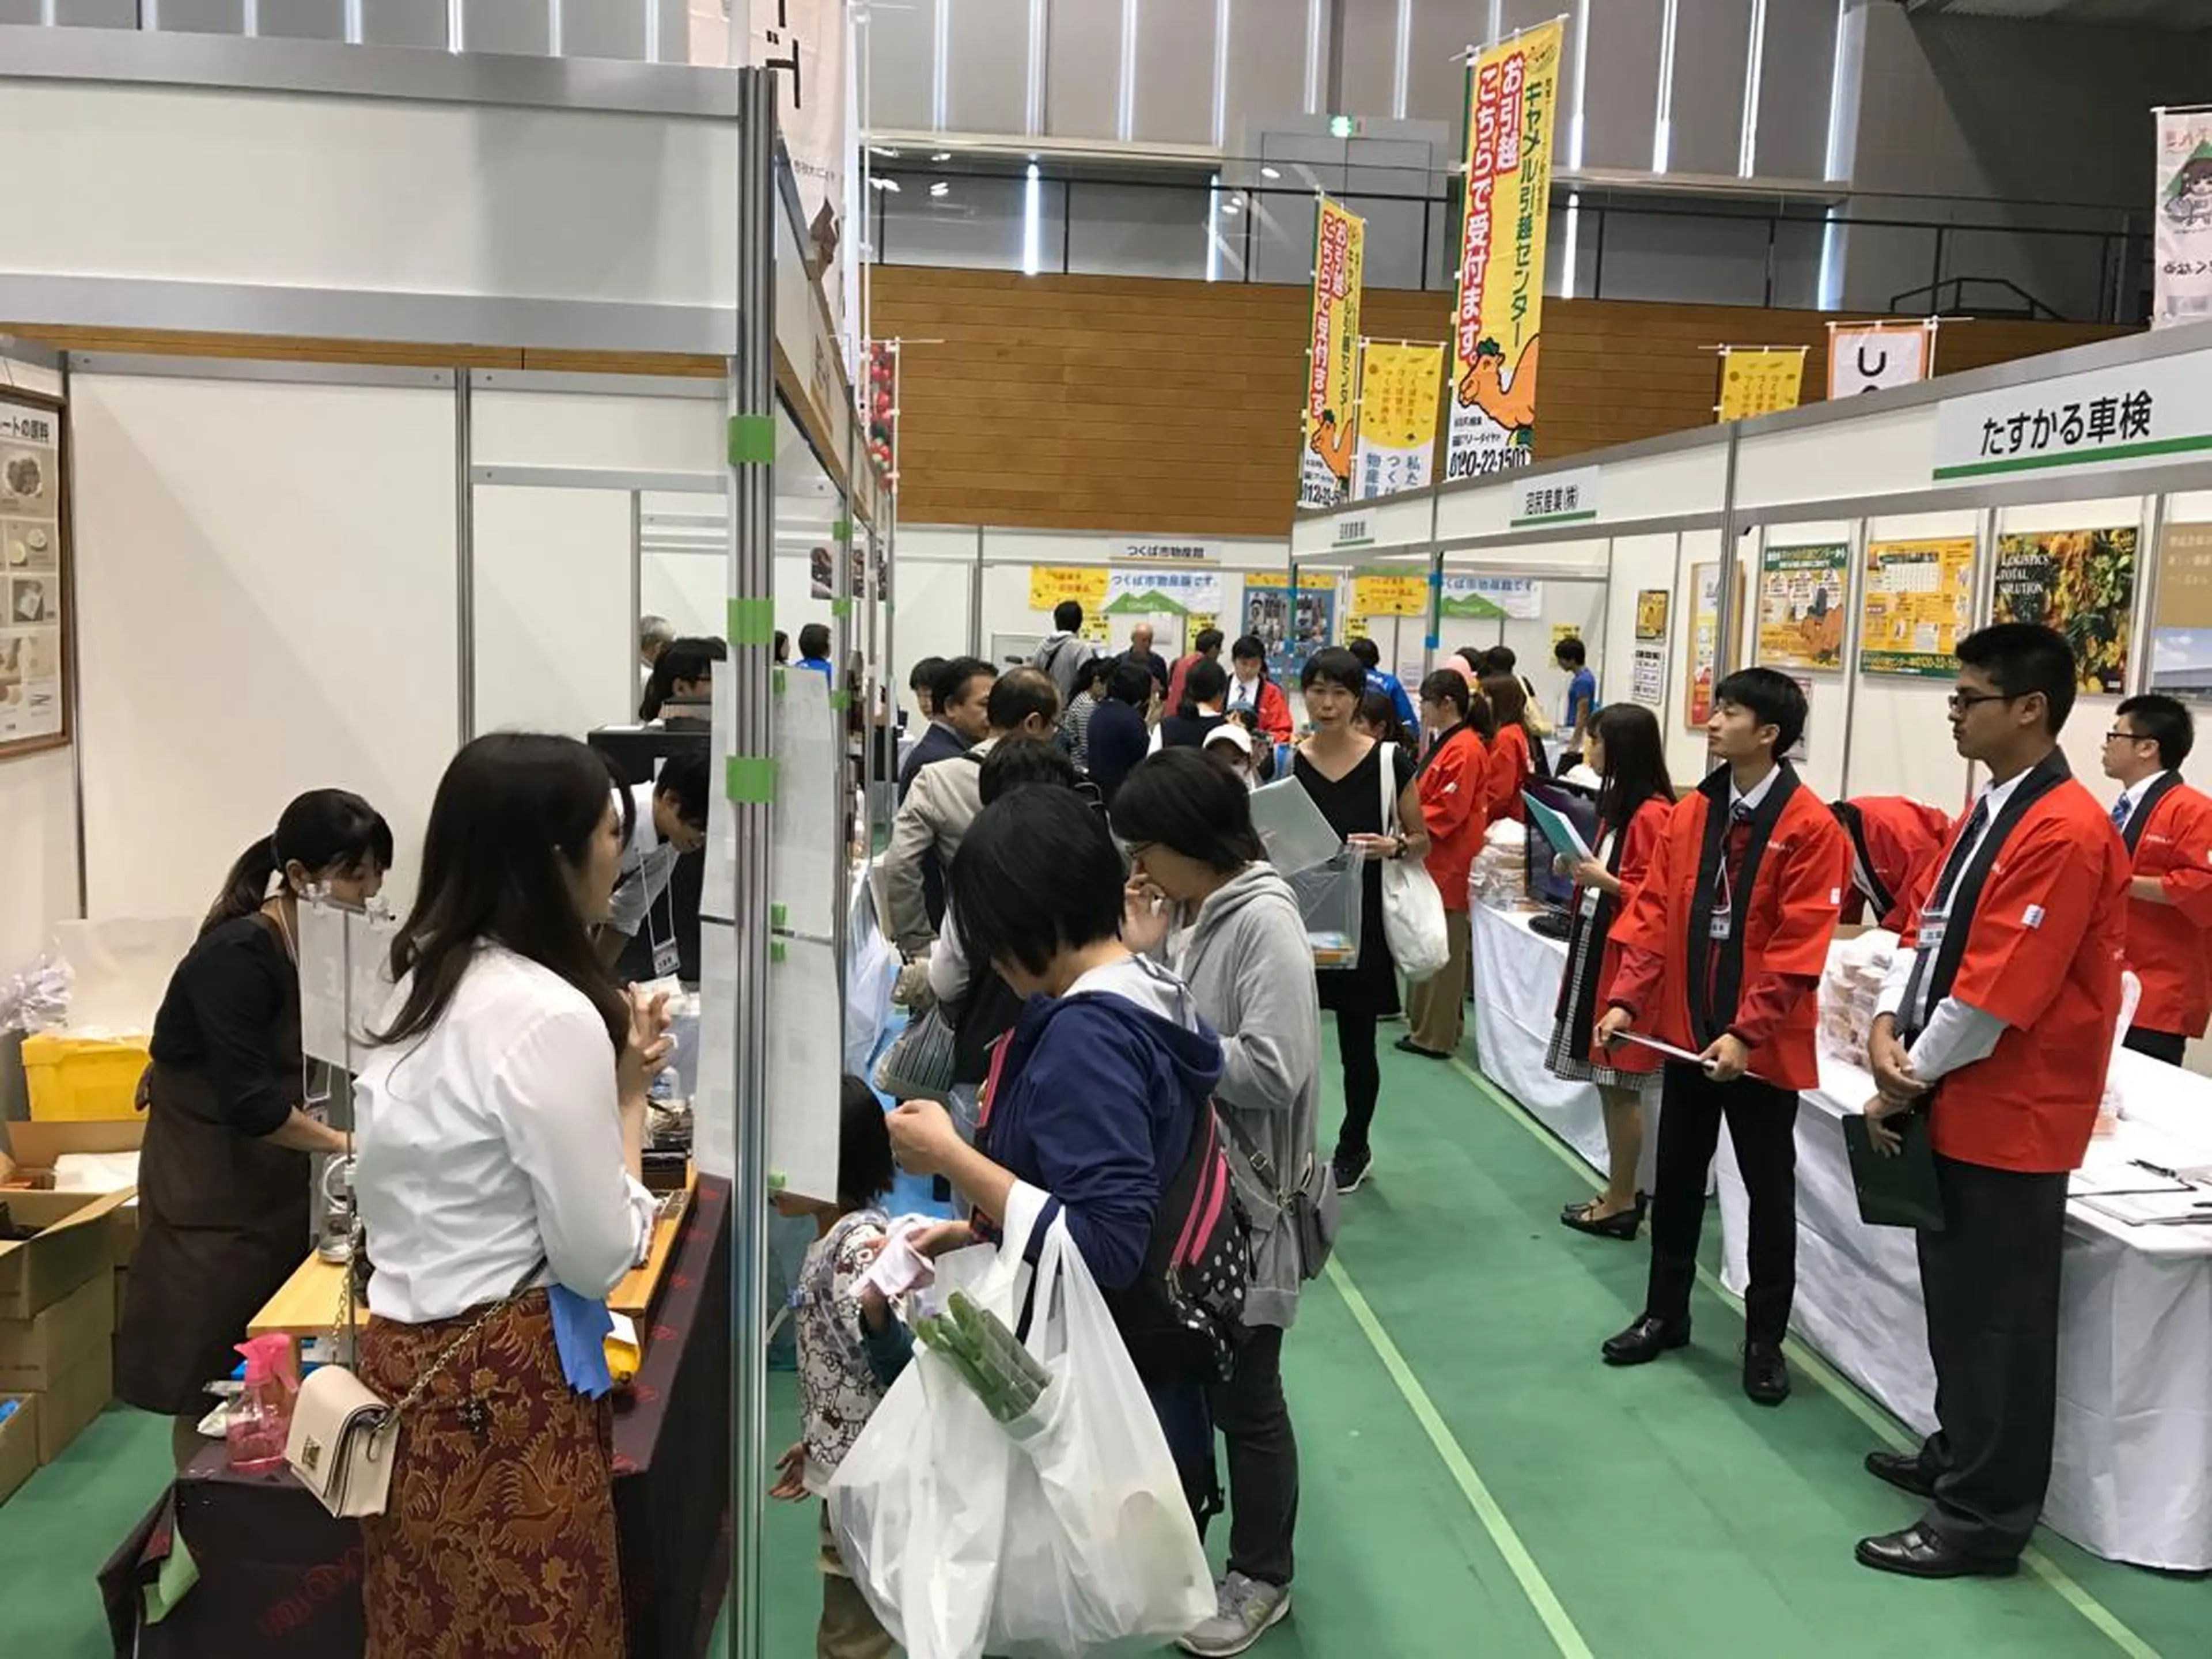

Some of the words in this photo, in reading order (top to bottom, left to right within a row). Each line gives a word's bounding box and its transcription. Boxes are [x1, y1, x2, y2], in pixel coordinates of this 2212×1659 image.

[1497, 56, 1523, 169] お引越
[1511, 81, 1542, 348] キャメル引越センター
[1980, 389, 2153, 456] たすかる車検
[1127, 546, 1204, 559] つくば市物産館
